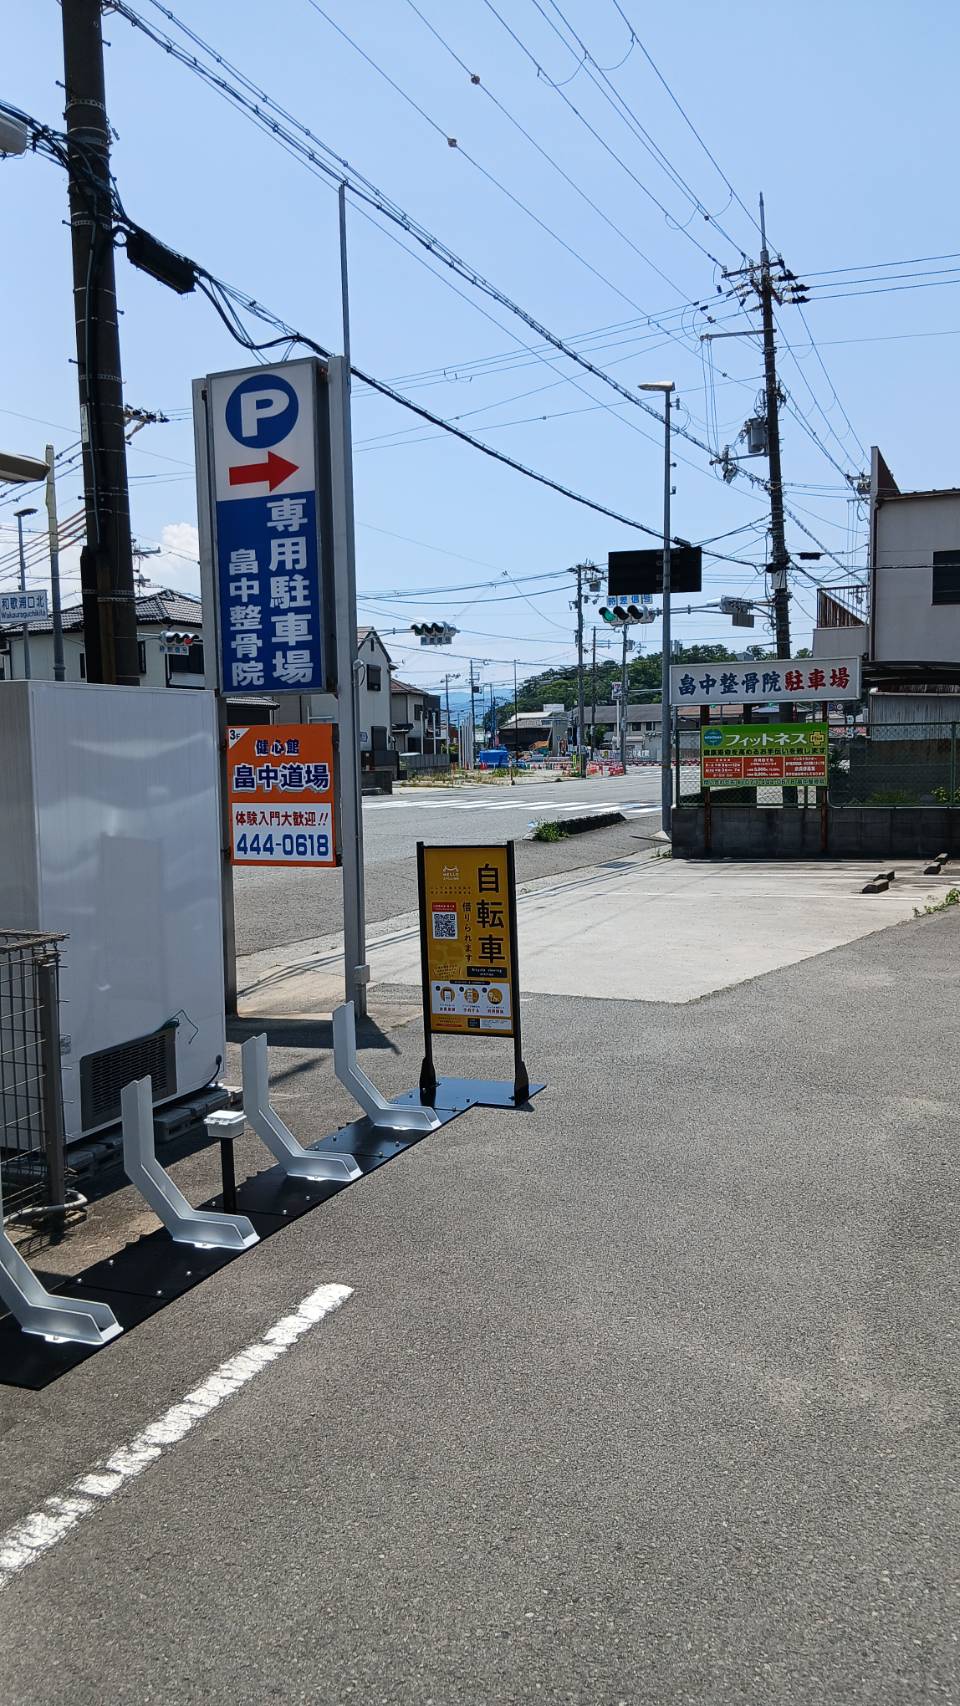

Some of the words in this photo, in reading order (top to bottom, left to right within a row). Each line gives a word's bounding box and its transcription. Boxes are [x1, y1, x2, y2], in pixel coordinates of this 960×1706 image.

[240, 389, 290, 438] P
[266, 497, 314, 685] 専用駐車場
[227, 548, 264, 688] 畠中整骨院
[678, 666, 851, 697] 畠中整骨院駐車場
[229, 730, 241, 741] 3F
[254, 739, 300, 756] 健心館
[726, 732, 807, 747] フィットネス
[233, 763, 330, 790] 畠中道場
[236, 833, 329, 857] 444-0618
[476, 863, 506, 964] 自転車
[462, 901, 472, 963] 借りられます
